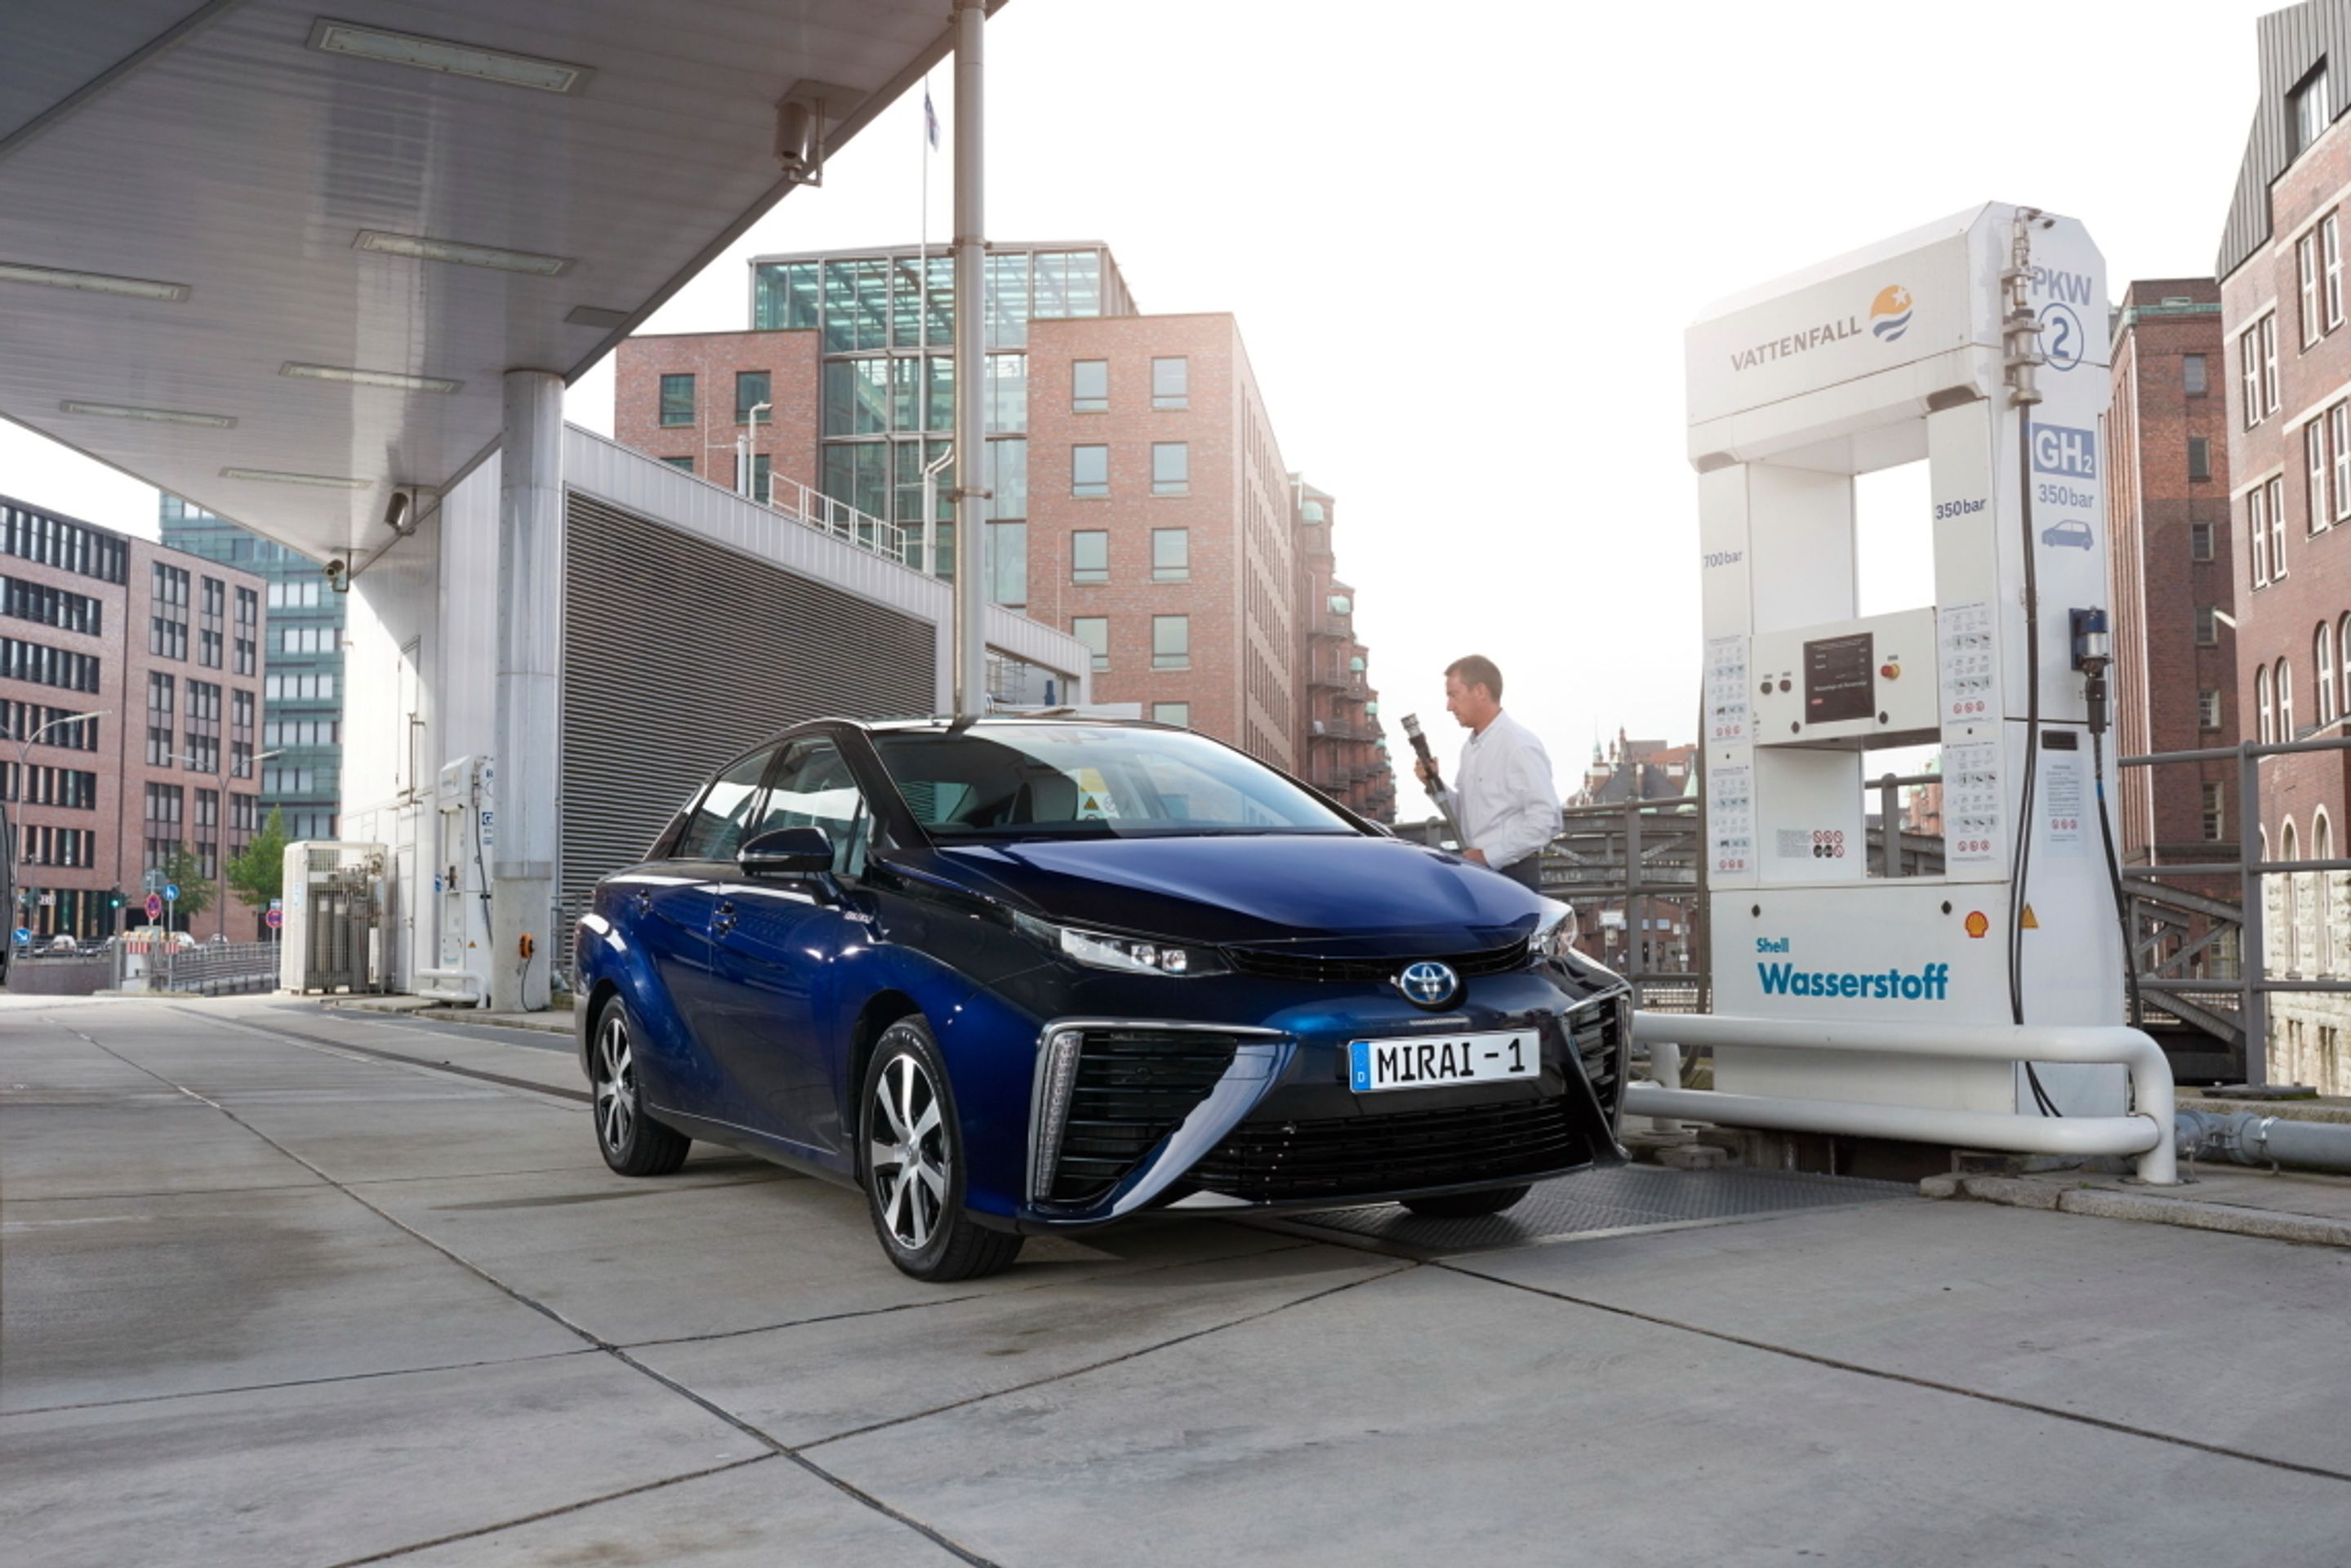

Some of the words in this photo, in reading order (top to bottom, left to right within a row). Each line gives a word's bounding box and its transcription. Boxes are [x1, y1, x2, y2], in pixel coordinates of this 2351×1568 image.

[2032, 265, 2092, 306] PKW
[1730, 315, 1862, 372] VATTENFALL
[2052, 316, 2070, 358] 2
[1757, 937, 1789, 953] Shell
[1757, 962, 1948, 1000] Wasserstoff
